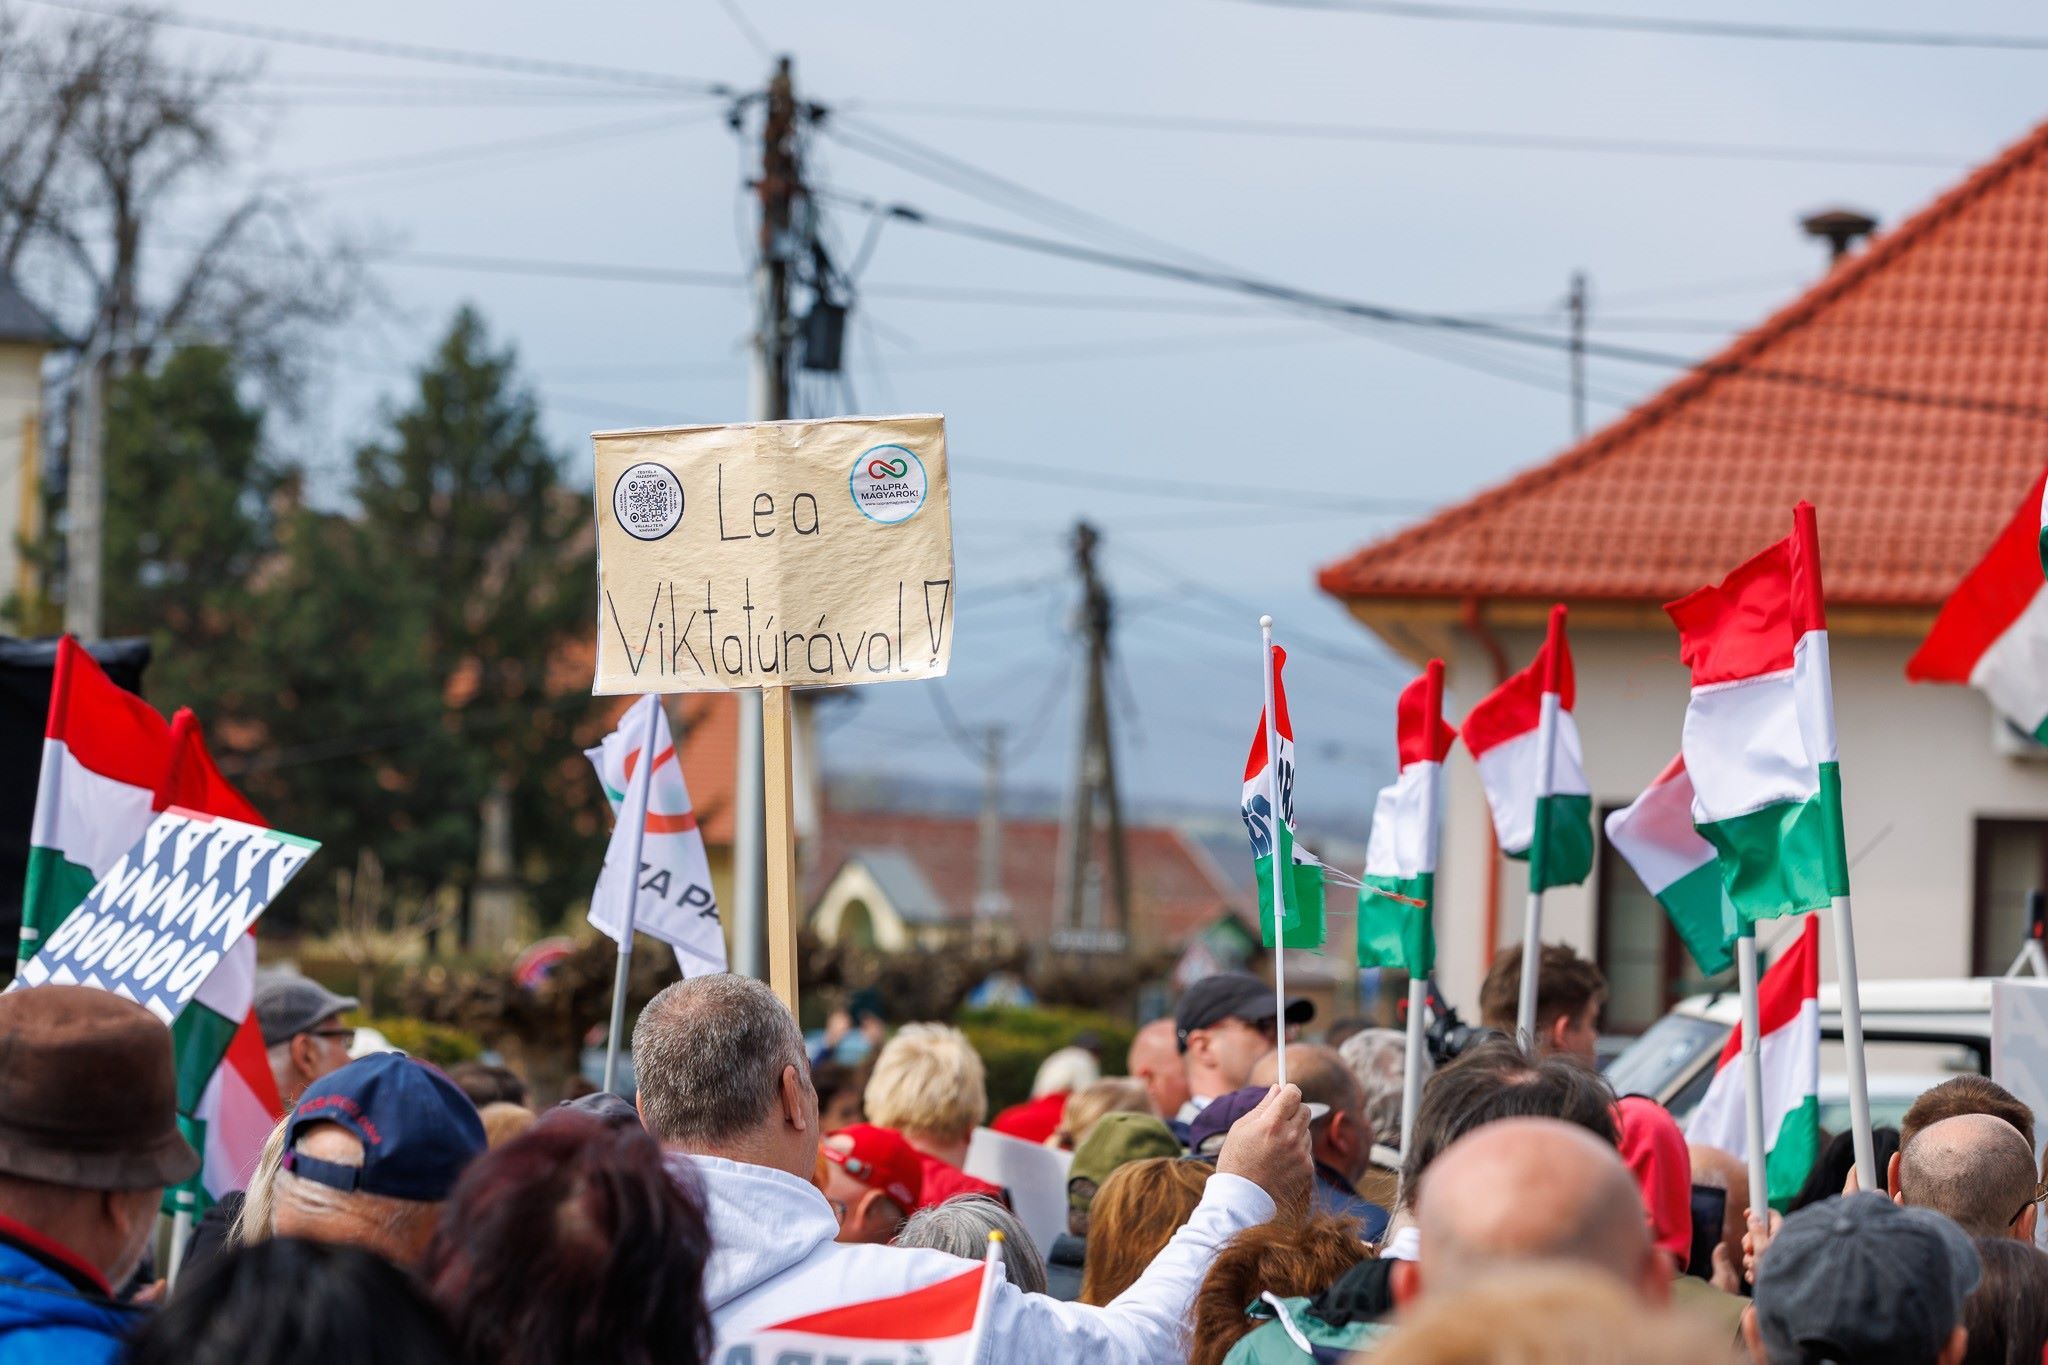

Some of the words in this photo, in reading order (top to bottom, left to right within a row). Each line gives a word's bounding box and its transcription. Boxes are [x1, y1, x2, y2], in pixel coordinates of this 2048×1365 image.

[870, 483, 909, 491] TALPRA
[861, 490, 919, 500] MAGYAROK!
[719, 463, 820, 541] Lea
